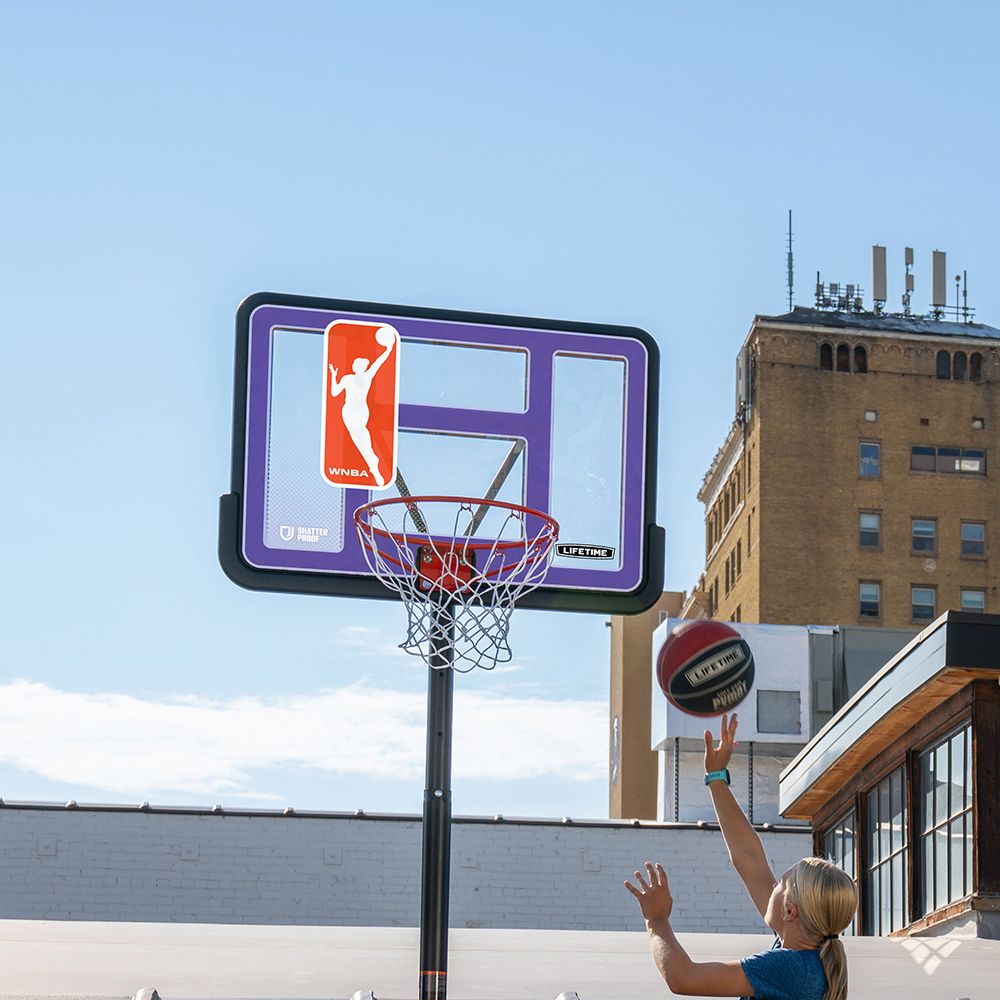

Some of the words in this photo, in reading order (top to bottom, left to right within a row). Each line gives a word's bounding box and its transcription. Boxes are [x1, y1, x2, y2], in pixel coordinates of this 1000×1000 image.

[328, 467, 369, 477] WNBA
[297, 527, 329, 536] SHATTER
[297, 535, 320, 543] PROOF
[563, 547, 607, 556] LIFETIME
[694, 650, 740, 681] LIFETIME
